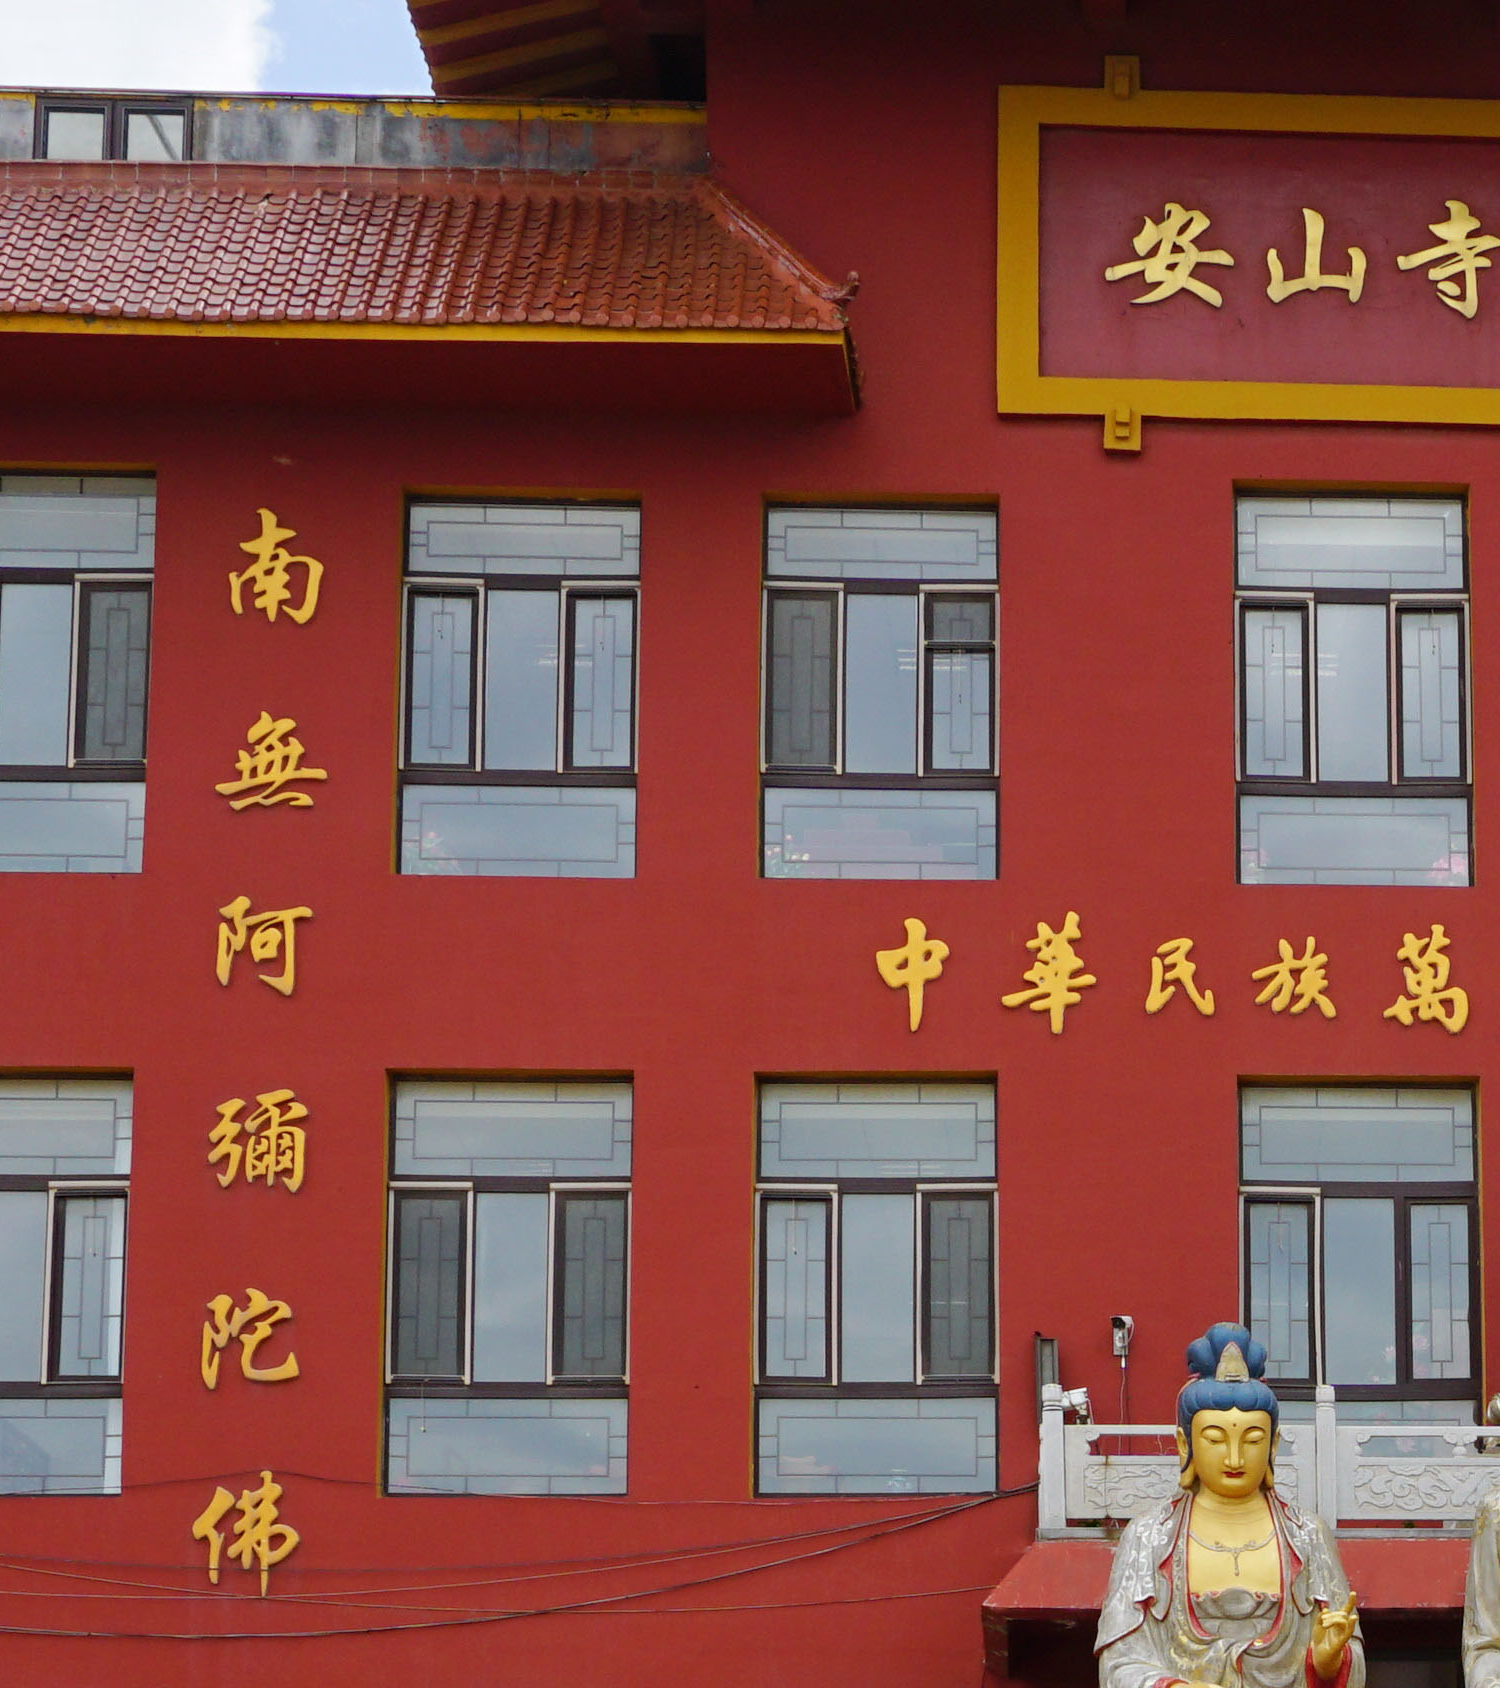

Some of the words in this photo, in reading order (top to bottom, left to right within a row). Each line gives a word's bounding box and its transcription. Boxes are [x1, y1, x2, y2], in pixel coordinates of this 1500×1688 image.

[190, 507, 329, 1599] 南無阿彌陀佛
